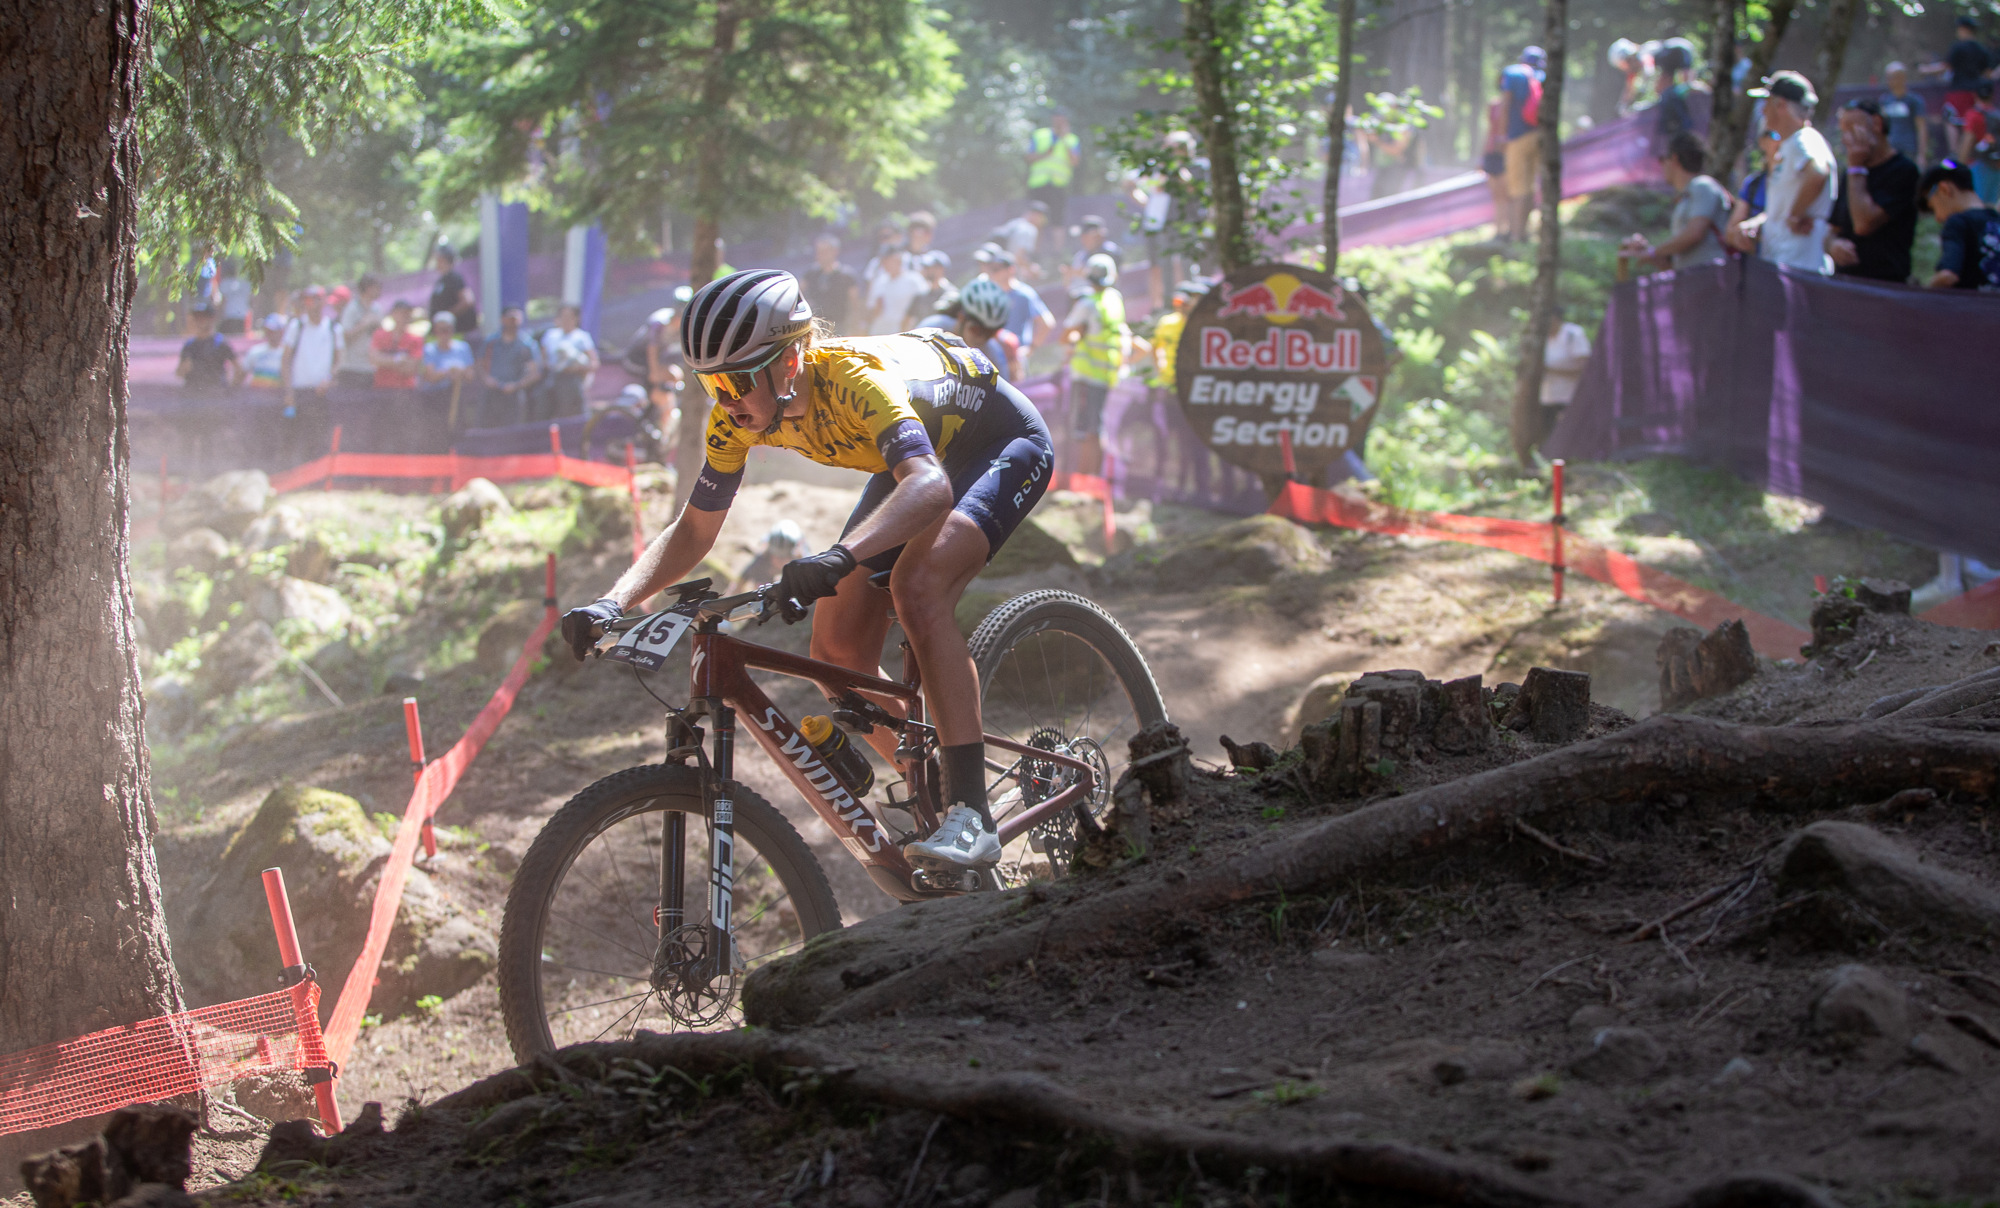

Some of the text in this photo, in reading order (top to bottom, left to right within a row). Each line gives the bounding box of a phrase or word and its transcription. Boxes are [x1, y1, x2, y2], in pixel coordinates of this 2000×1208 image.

[1201, 326, 1361, 372] Red Bull
[932, 379, 955, 408] KEEP
[1190, 375, 1320, 414] Energy
[1212, 414, 1349, 447] Section
[1013, 443, 1053, 509] ROUVY
[632, 620, 677, 645] 45
[749, 706, 891, 853] S-WORKS
